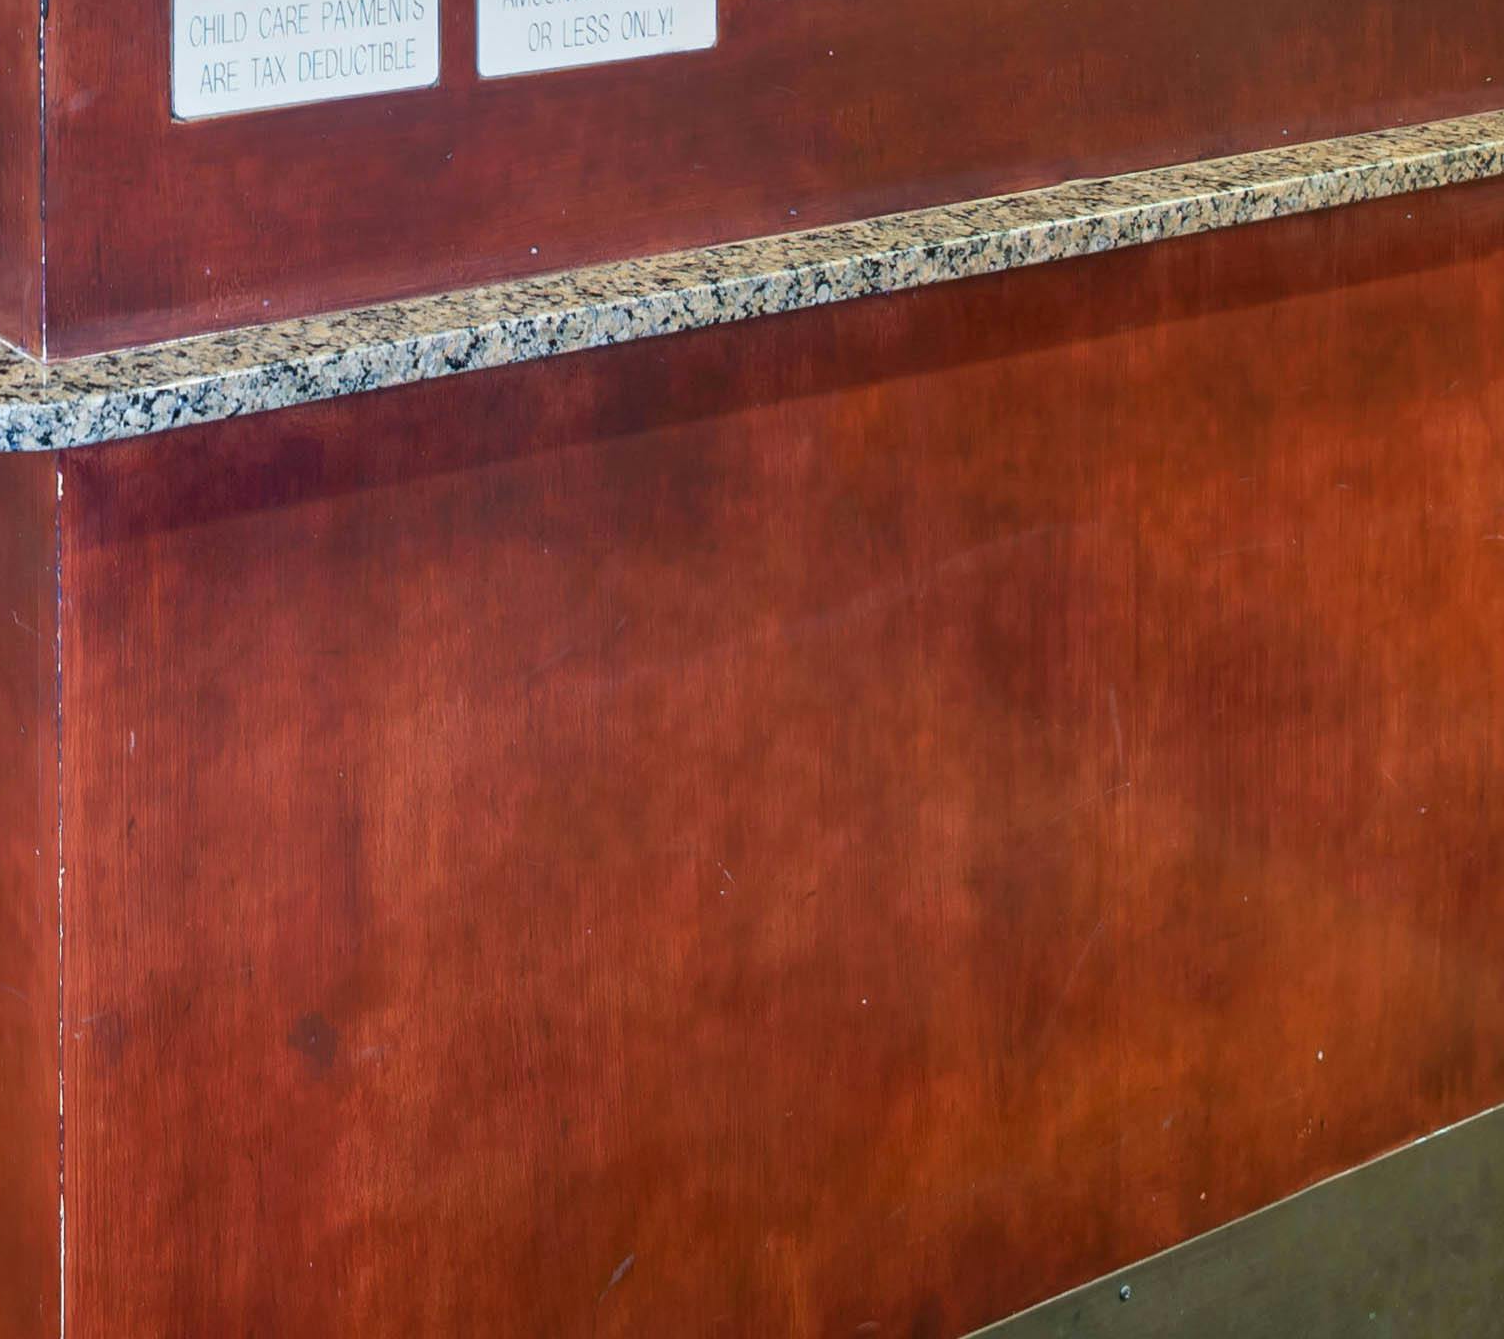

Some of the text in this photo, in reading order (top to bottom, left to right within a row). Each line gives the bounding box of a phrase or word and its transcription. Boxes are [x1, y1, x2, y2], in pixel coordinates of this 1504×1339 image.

[189, 11, 248, 47] CHILD
[259, 3, 310, 39] CARE
[528, 6, 674, 52] OR LESS ONLY!
[200, 38, 416, 95] ARE TAX DEDUCTIBLE
